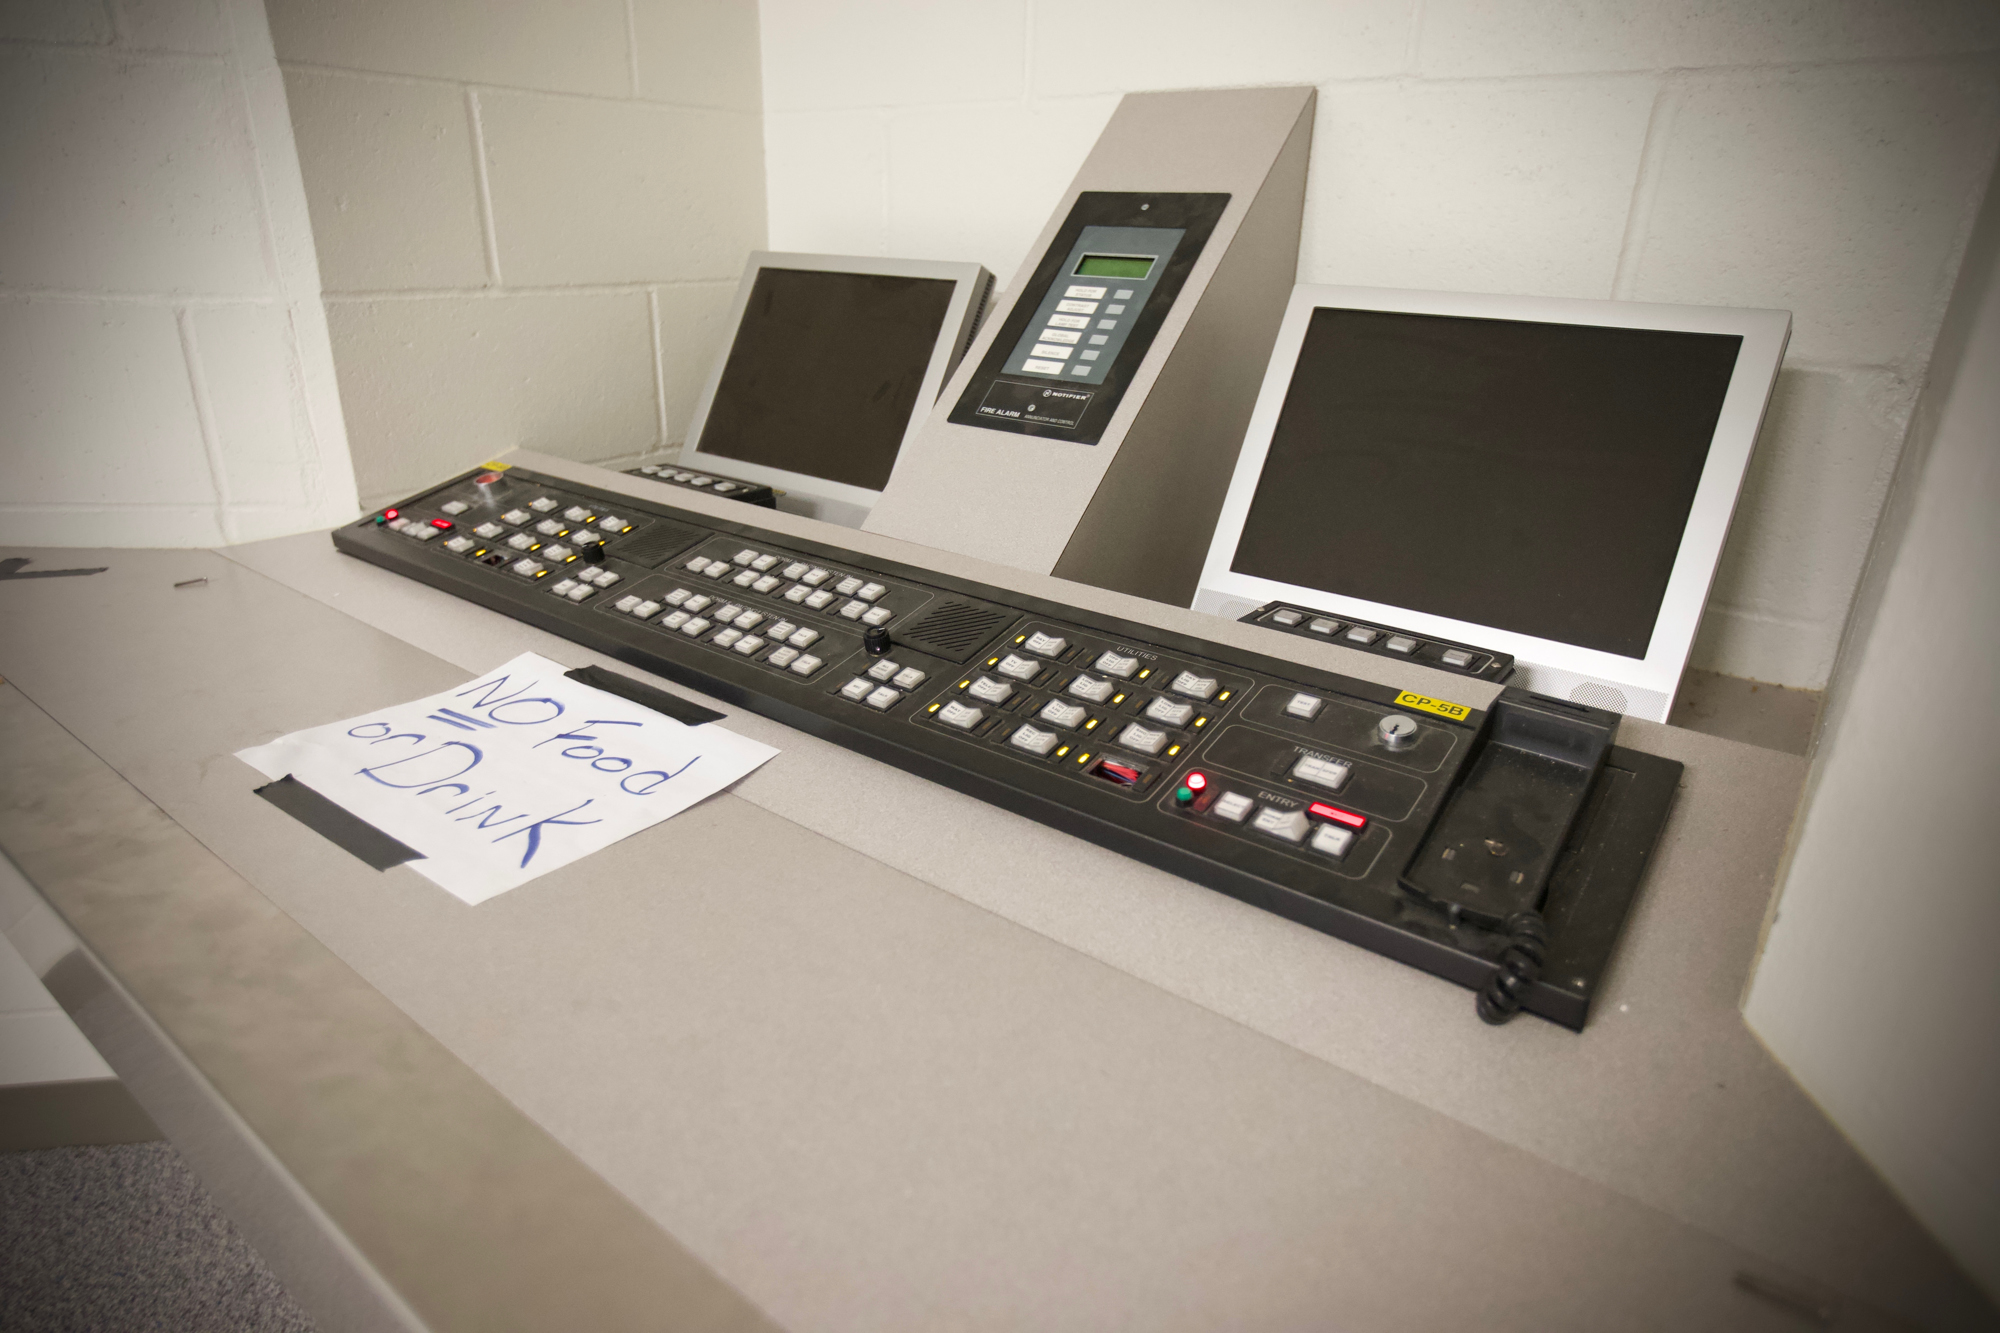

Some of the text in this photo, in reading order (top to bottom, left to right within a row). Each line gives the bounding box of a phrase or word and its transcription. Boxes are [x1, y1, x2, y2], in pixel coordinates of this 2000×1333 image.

[980, 406, 1020, 418] FIRE ALARM
[1024, 414, 1049, 422] ANNUNCIATOR
[1057, 418, 1074, 426] CONTROL
[1117, 646, 1158, 661] UTILITIES
[1401, 694, 1465, 716] CP-5B
[347, 722, 427, 746] or
[456, 674, 703, 795] NO Food
[1293, 746, 1353, 769] TRANSFER
[1257, 791, 1299, 808] ENTRY
[1324, 833, 1341, 842] TALK
